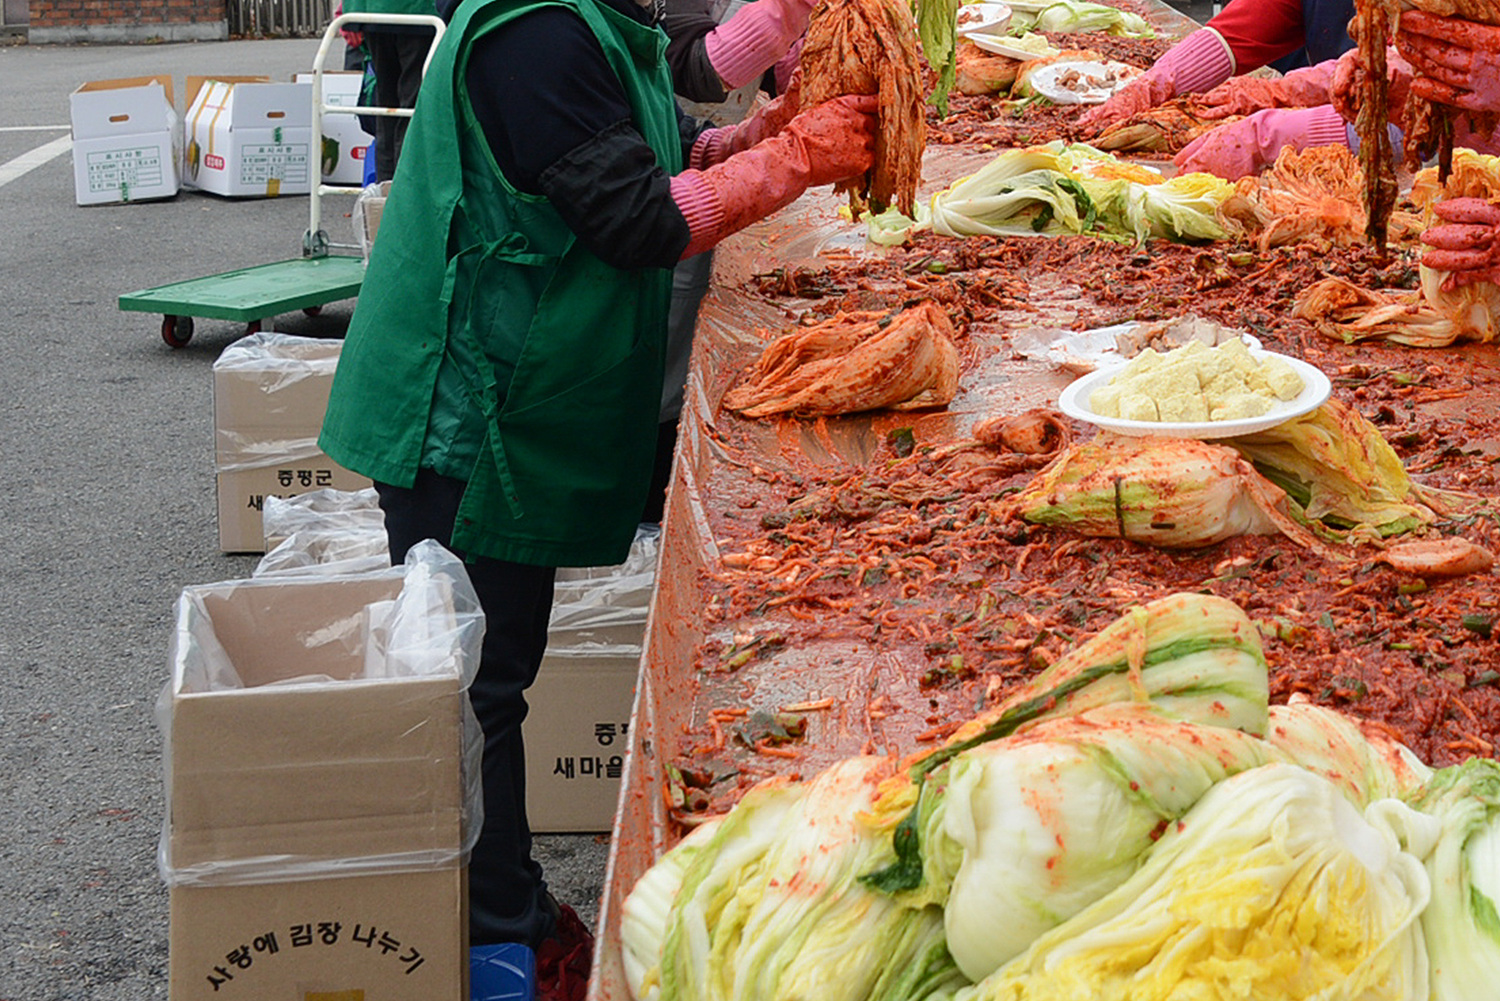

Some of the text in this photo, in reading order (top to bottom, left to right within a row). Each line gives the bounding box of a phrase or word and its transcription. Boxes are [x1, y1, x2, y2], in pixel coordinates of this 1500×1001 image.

[278, 470, 332, 487] 증평군
[553, 756, 623, 779] 새마을
[206, 922, 425, 991] 사랑에 김장 나누기
